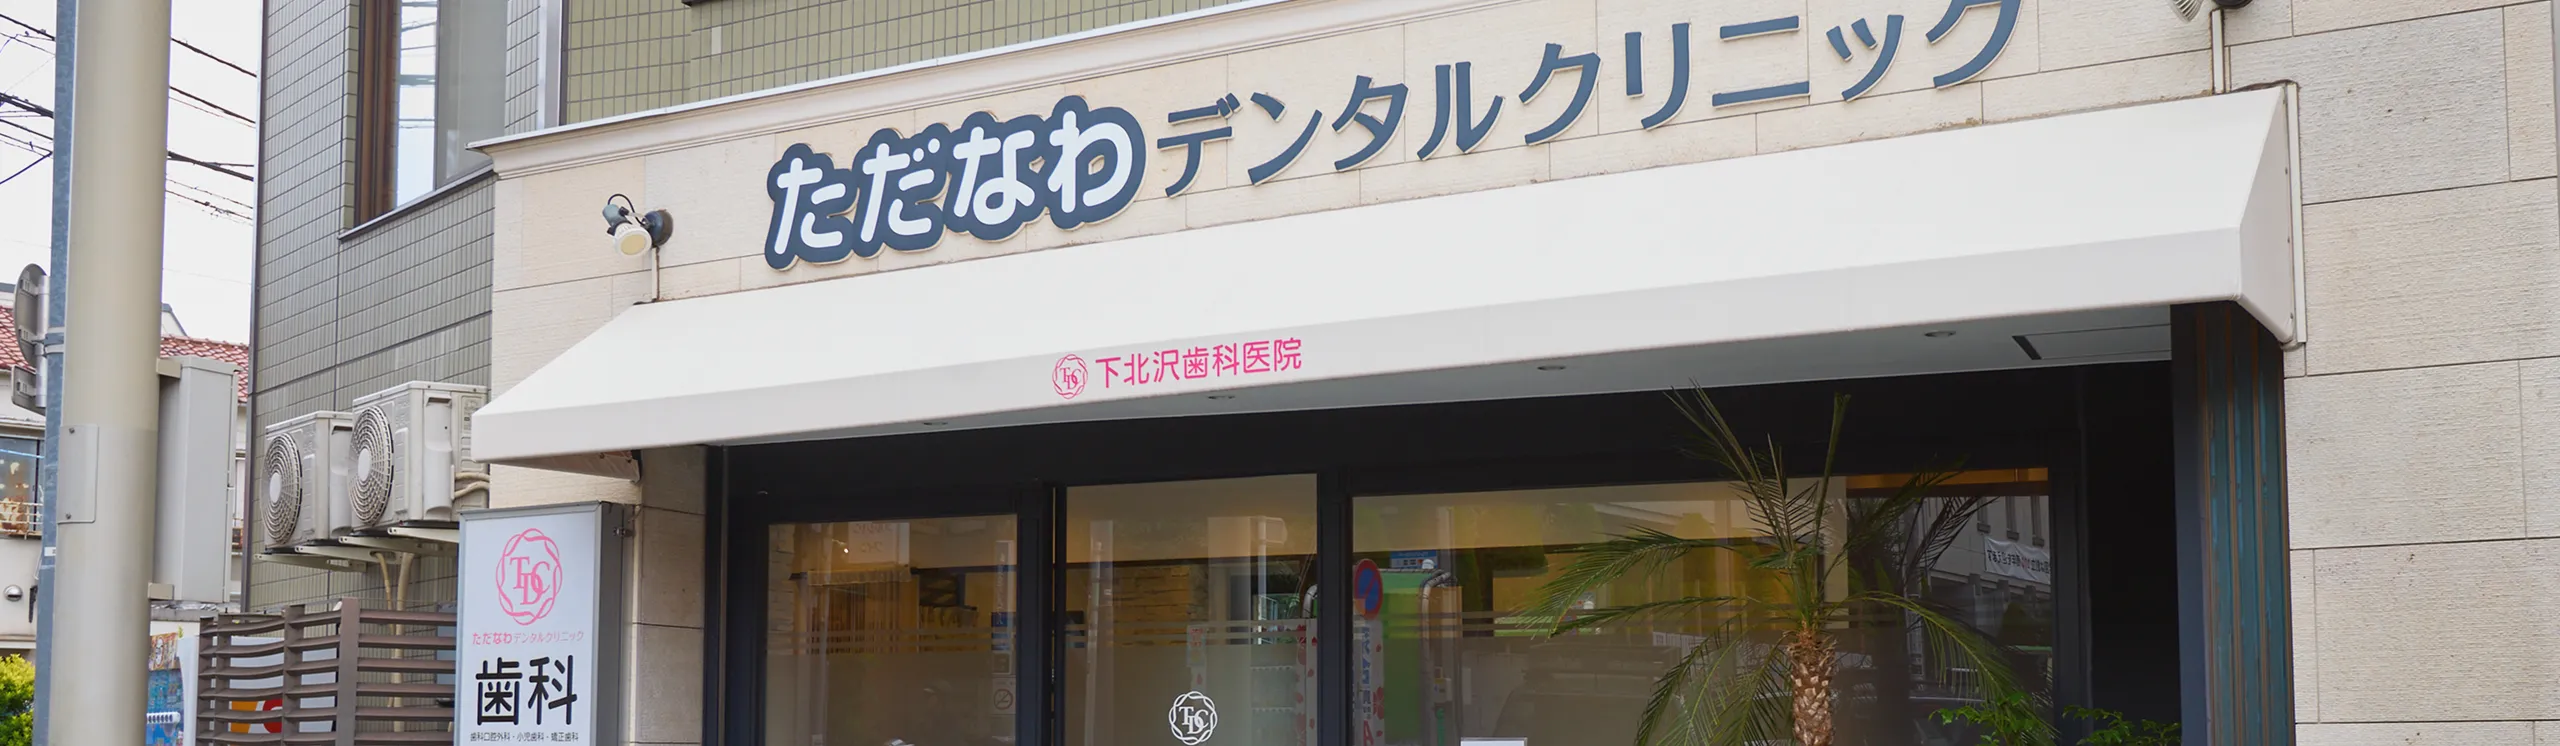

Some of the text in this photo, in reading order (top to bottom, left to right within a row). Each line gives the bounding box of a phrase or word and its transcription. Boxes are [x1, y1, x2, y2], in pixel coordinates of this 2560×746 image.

[1095, 337, 1302, 389] 下北沢歯科医院
[475, 655, 577, 725] 歯科
